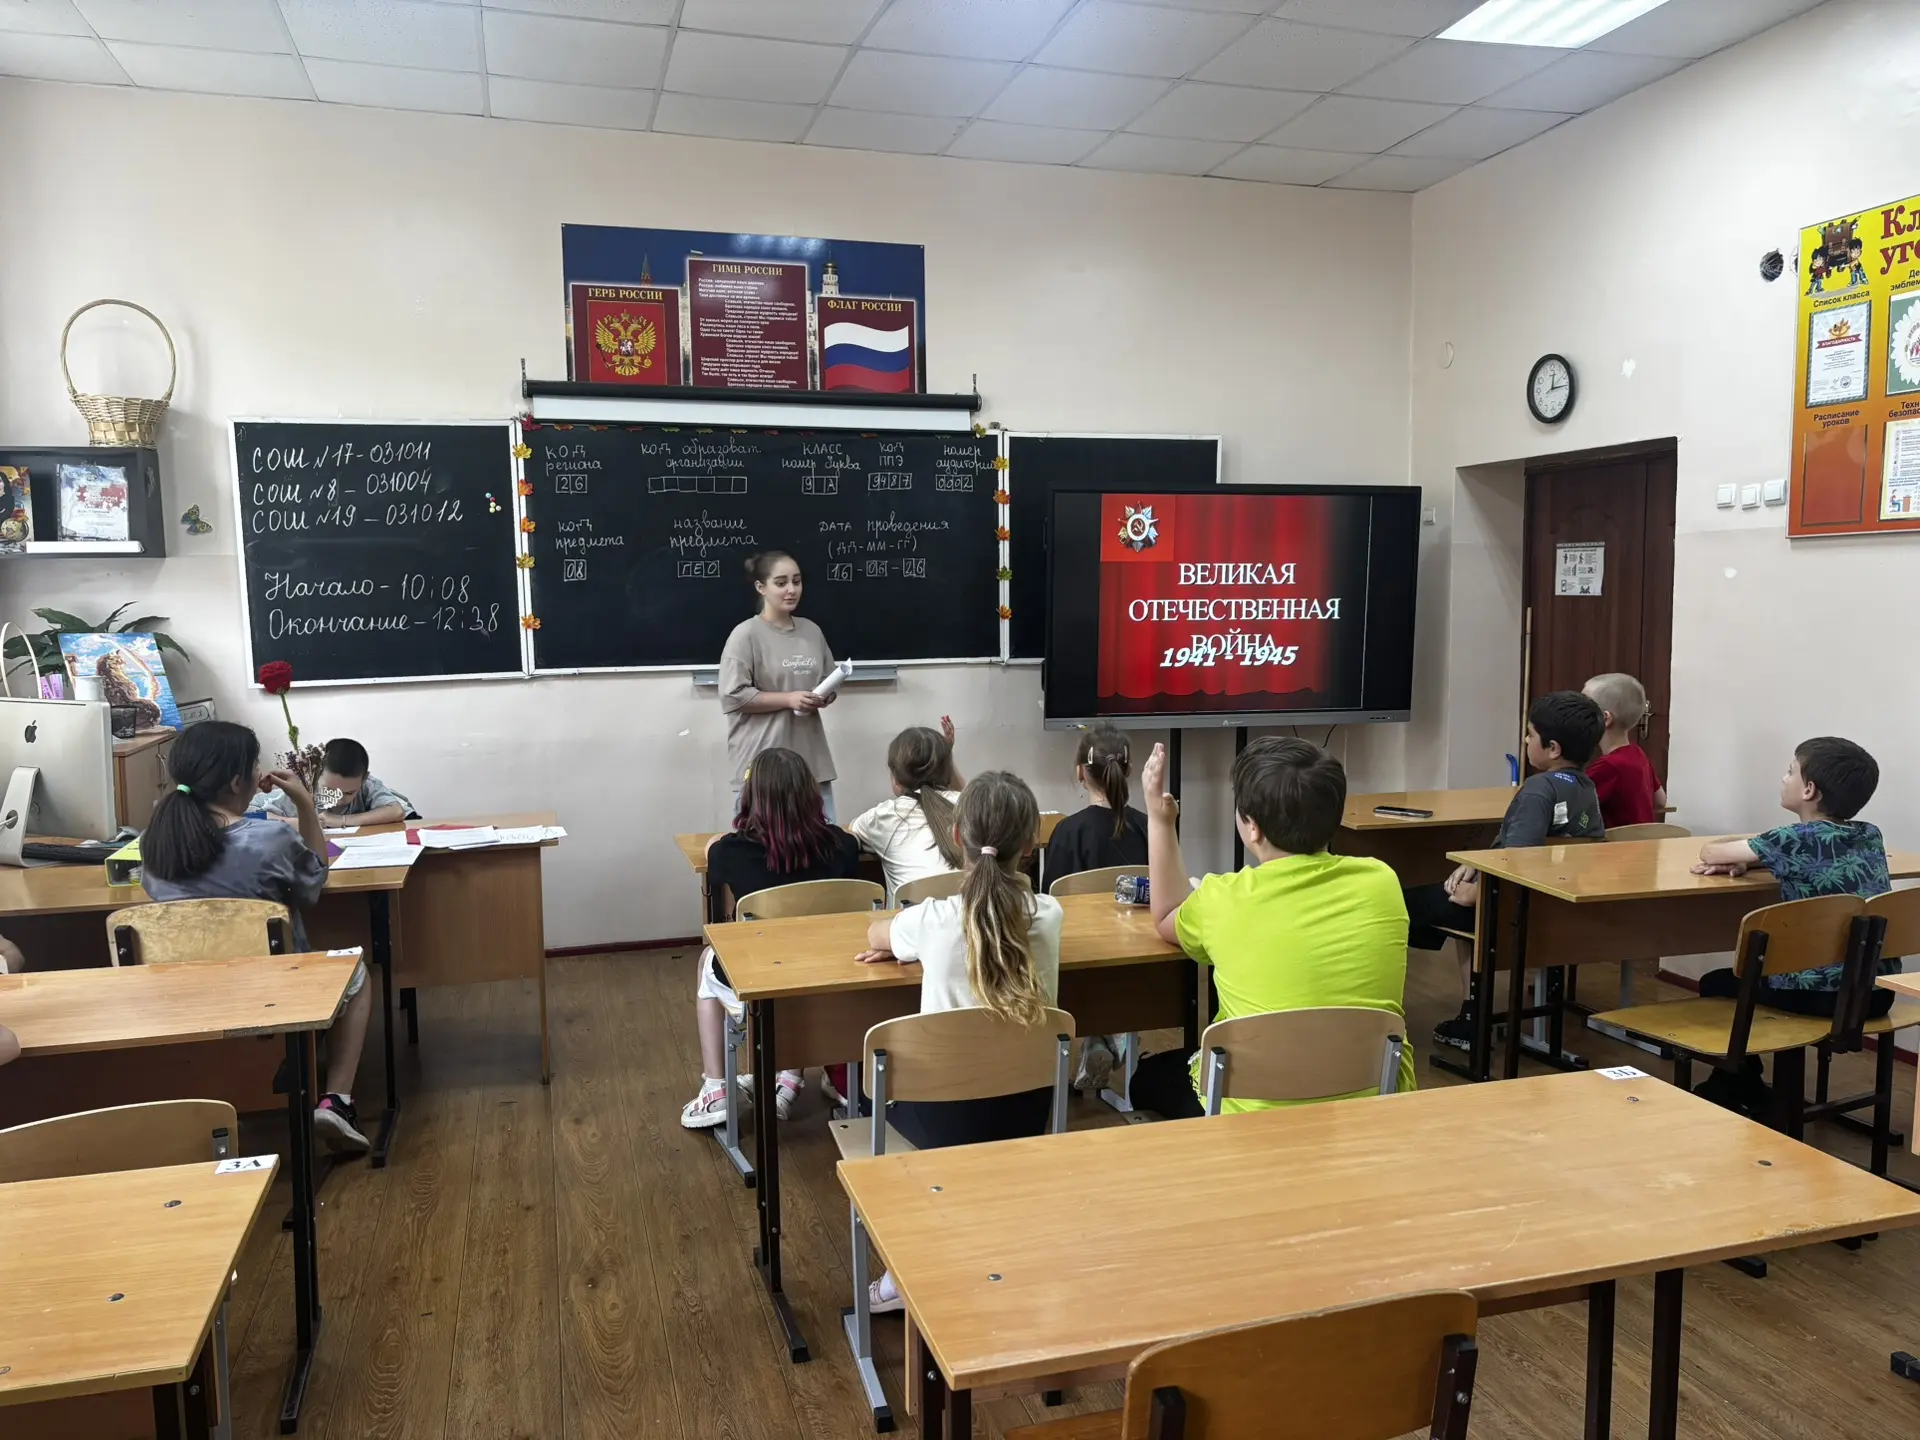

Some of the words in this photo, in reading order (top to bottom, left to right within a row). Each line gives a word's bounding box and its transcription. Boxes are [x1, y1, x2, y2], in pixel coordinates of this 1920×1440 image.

[712, 263, 742, 275] ГИМН
[744, 264, 783, 276] РОССИИ
[588, 287, 617, 299] ГЕРБ
[619, 288, 663, 301] РОССИИ
[1813, 296, 1842, 308] Список
[1842, 290, 1870, 302] класса
[827, 299, 858, 311] ФЛАГ
[860, 300, 902, 312] РОССИИ
[1813, 409, 1860, 421] Расписание
[1822, 417, 1850, 428] уроков
[803, 442, 843, 455] КЛАСС
[944, 444, 982, 464] номер
[252, 447, 310, 474] СОШ
[545, 460, 603, 477] региона
[781, 458, 816, 474] номер
[825, 454, 861, 474] буква
[879, 455, 904, 467] ППЭ
[253, 483, 302, 506] СОШ
[252, 509, 310, 534] СОШ
[386, 499, 464, 527] 031012
[673, 509, 747, 536] название
[867, 510, 950, 539] проведения
[555, 536, 625, 555] предмета
[669, 535, 758, 558] предмета
[1178, 563, 1296, 585] ВЕЛИКАЯ
[264, 571, 374, 601] Начало
[1128, 598, 1341, 622] ОТЕЧЕСТВЕННАЯ
[268, 608, 412, 640] Окончание
[1190, 628, 1276, 657] ВОЙНА
[1159, 648, 1217, 668] 1941
[1239, 646, 1298, 666] 1945
